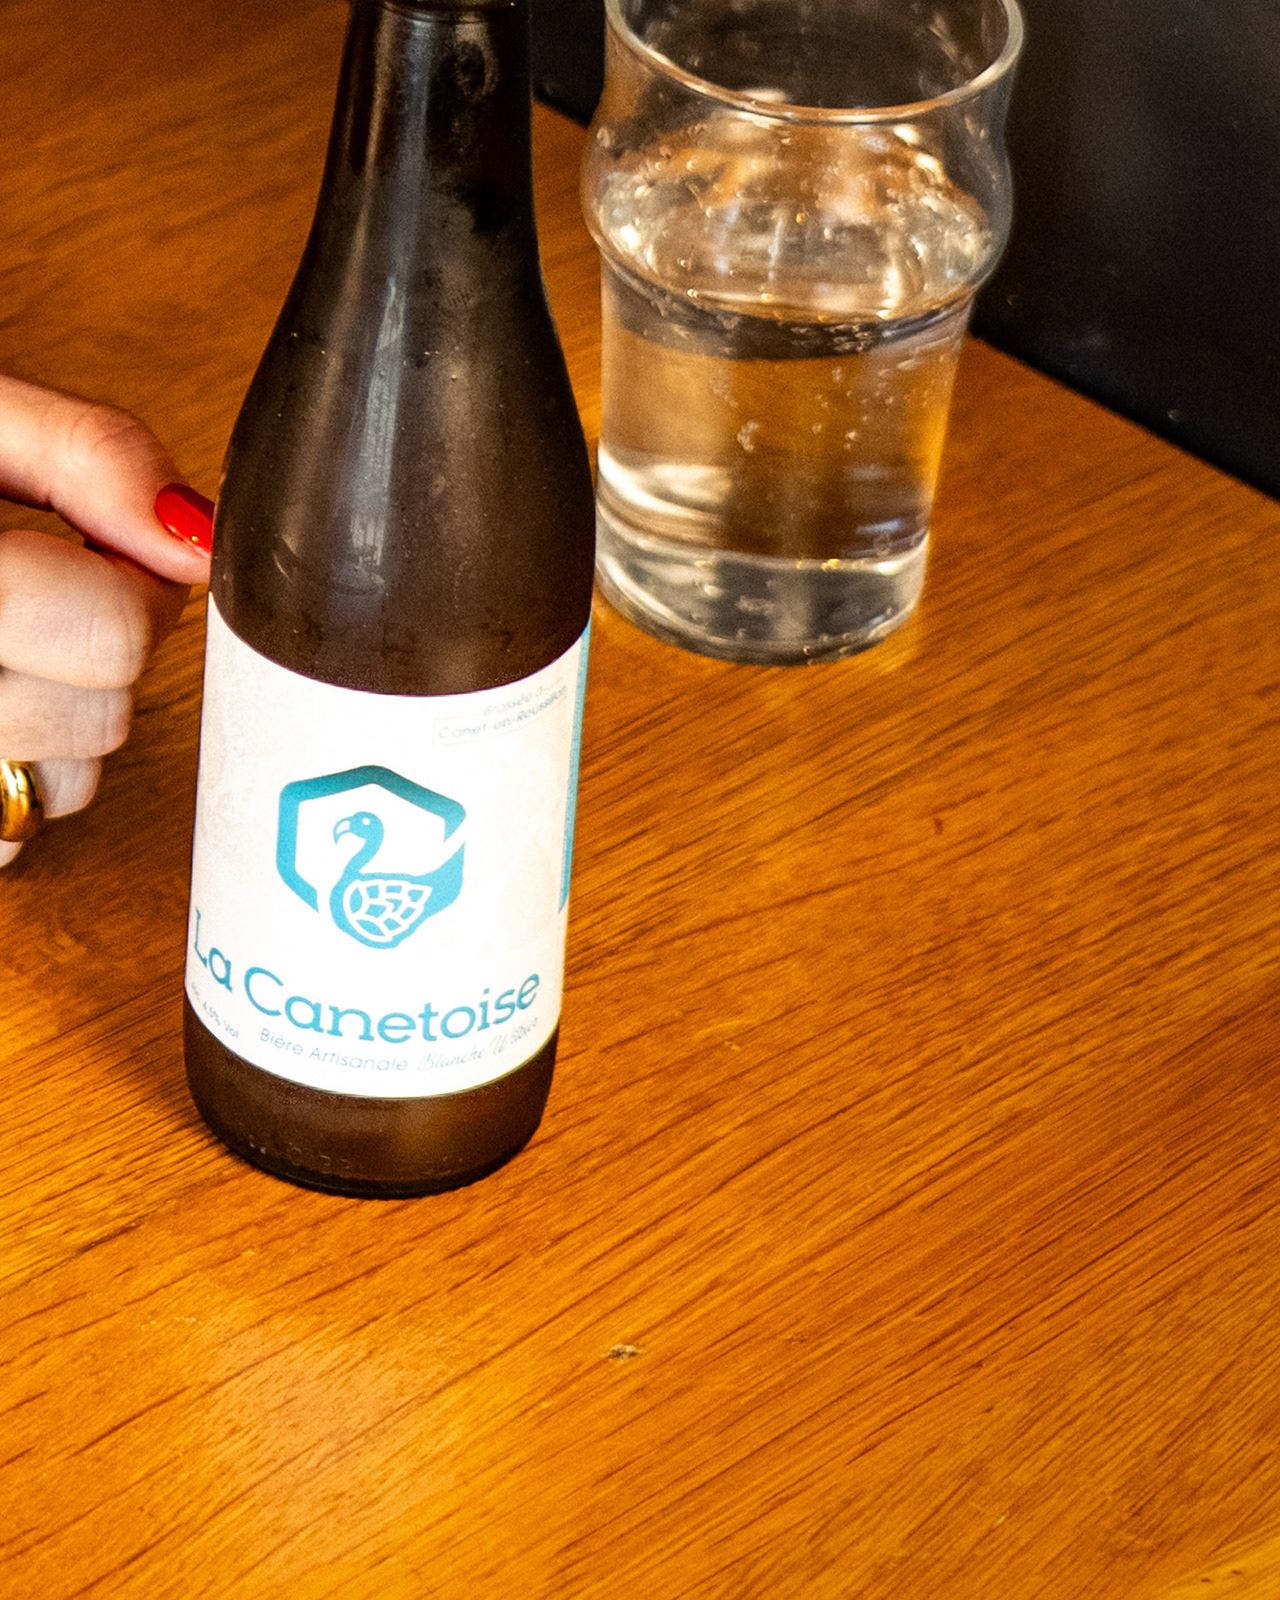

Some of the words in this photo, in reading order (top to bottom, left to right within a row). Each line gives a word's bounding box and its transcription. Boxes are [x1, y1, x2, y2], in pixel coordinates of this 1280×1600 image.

[193, 906, 233, 993] La
[243, 966, 540, 1044] Canetoise
[259, 1027, 304, 1056] Bière
[308, 1047, 409, 1072] Artisanale
